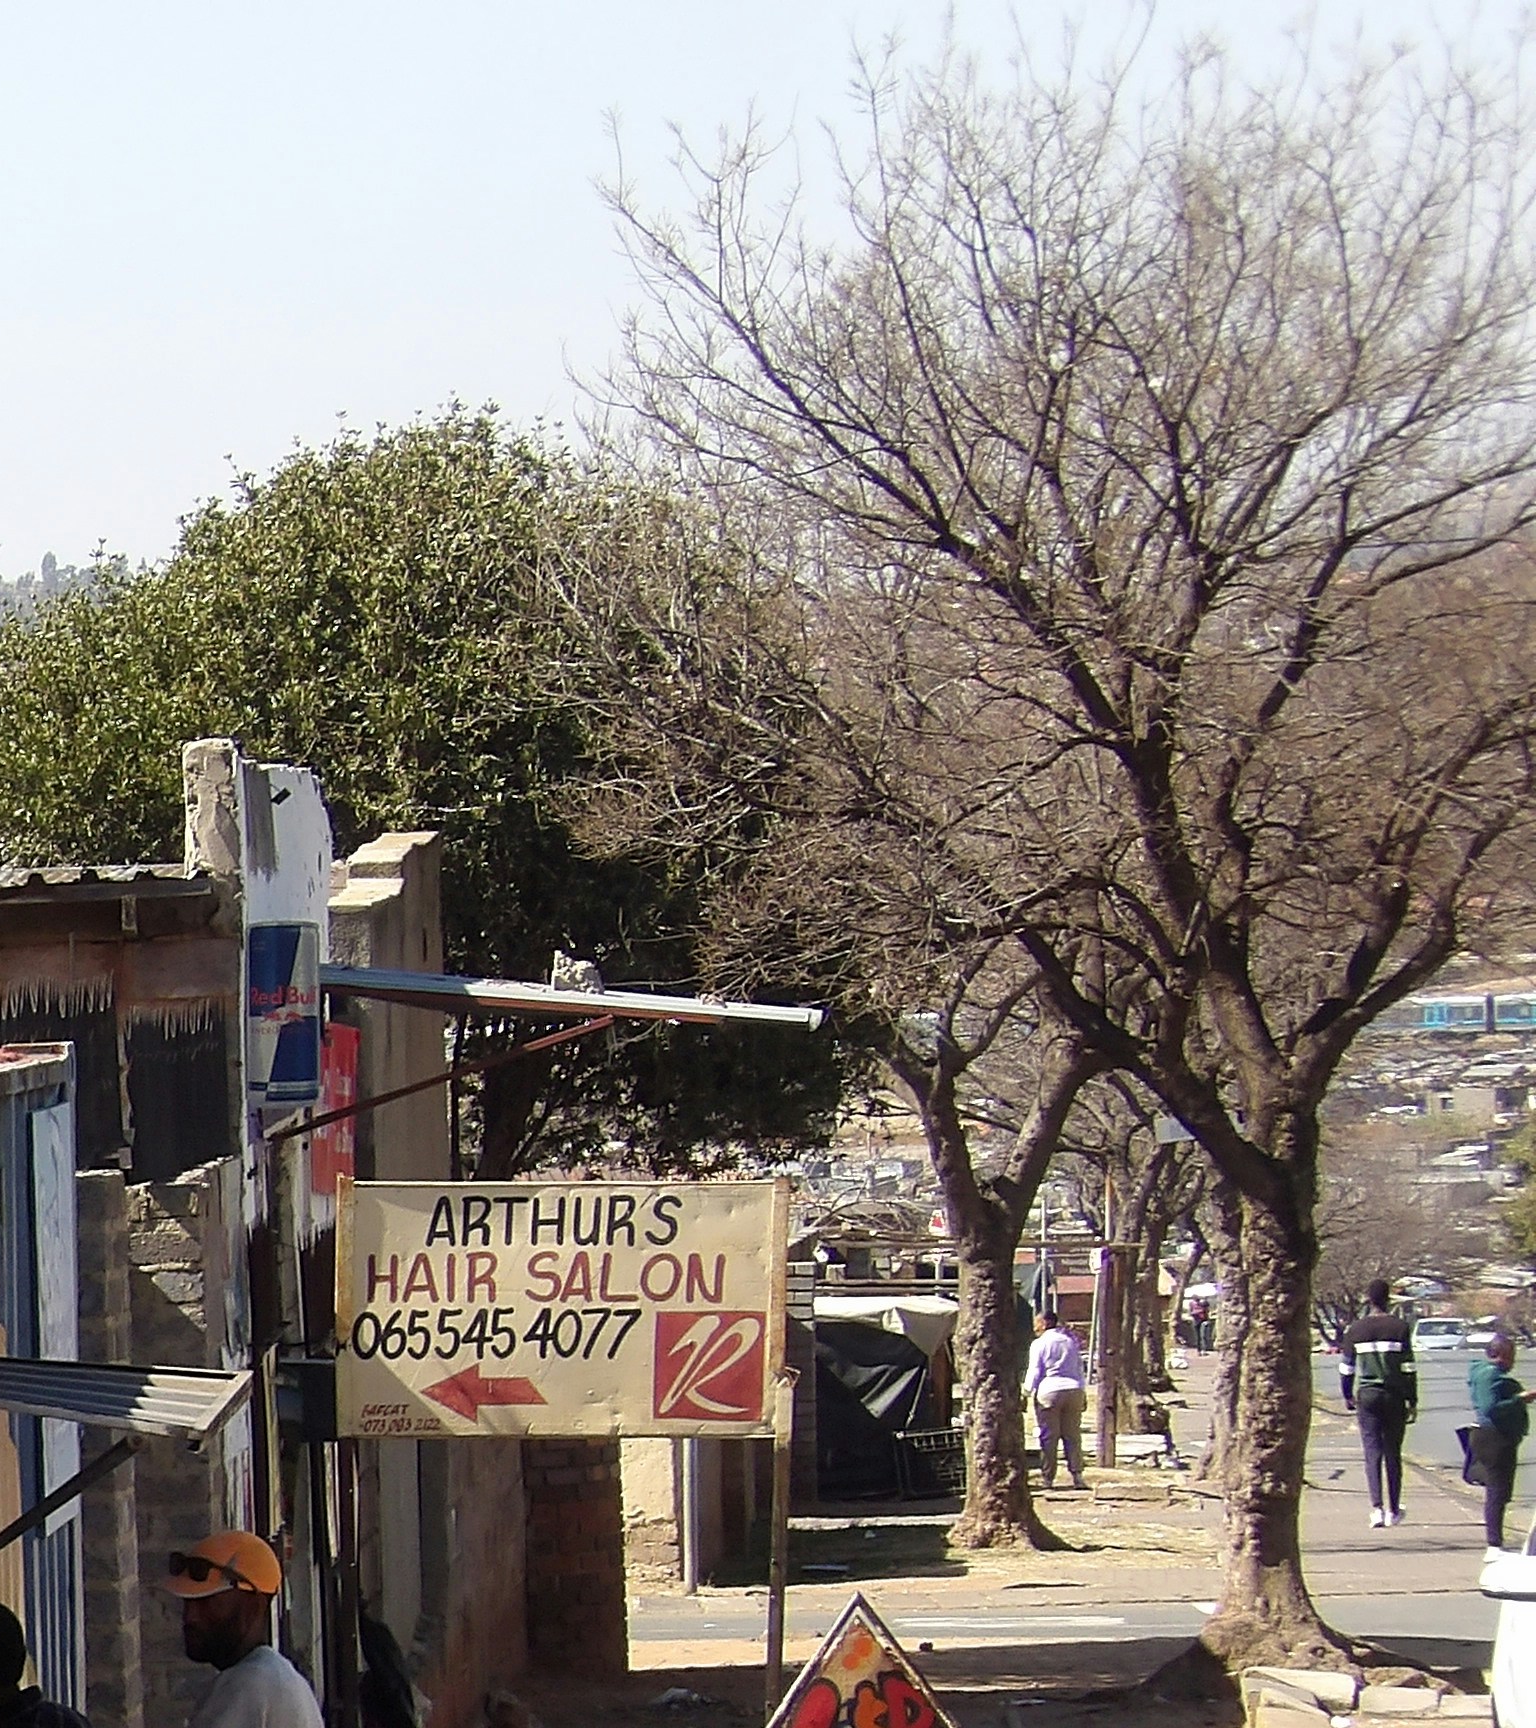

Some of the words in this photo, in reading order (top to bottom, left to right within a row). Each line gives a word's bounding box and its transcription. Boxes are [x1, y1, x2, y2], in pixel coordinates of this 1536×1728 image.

[425, 1194, 684, 1248] ARTHUR'S
[366, 1251, 499, 1304] HAIR
[524, 1250, 727, 1304] SALON
